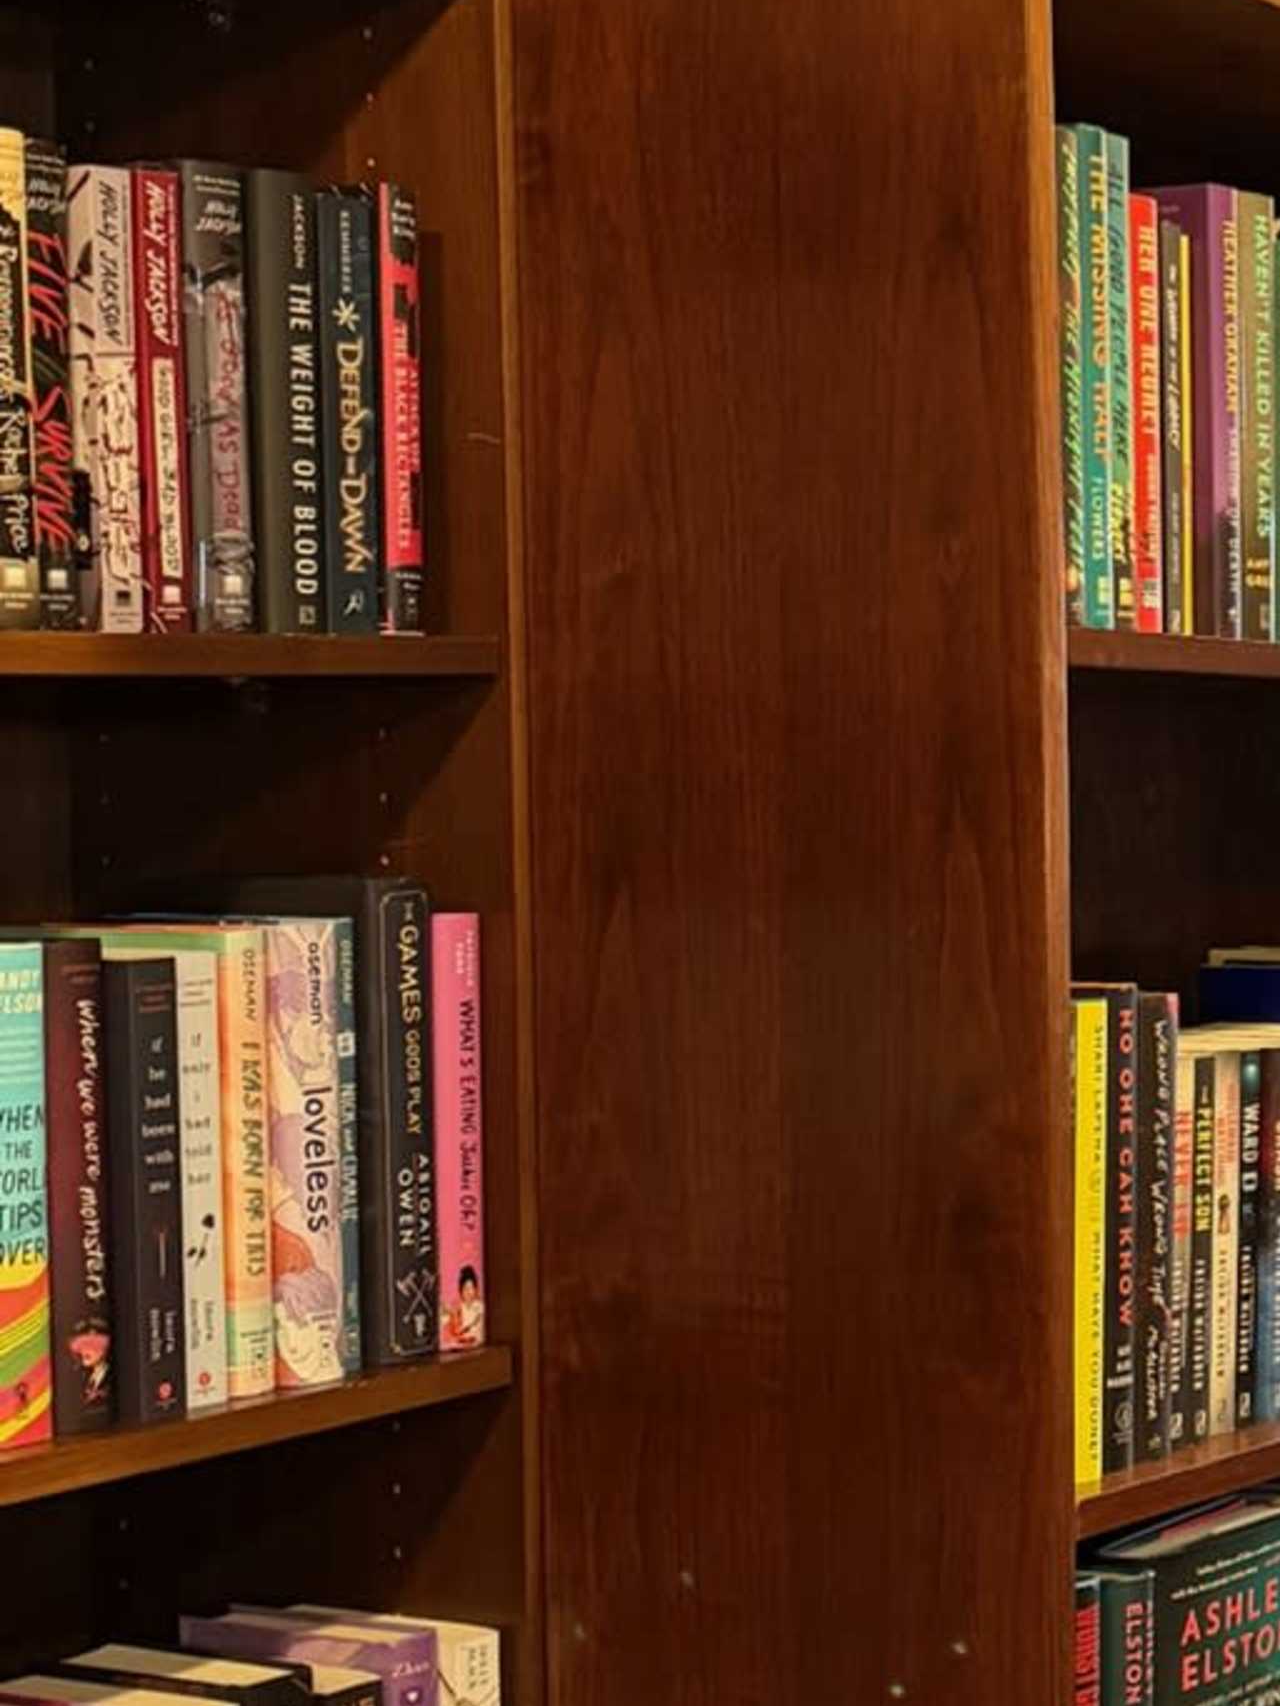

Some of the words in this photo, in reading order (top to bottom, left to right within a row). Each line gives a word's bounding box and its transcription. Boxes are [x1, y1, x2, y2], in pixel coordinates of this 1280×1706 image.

[144, 180, 164, 246] HOLLY
[1088, 154, 1107, 212] THE
[27, 230, 66, 340] FIVE
[1138, 225, 1157, 275] HER
[99, 250, 126, 346] JACKSON
[146, 249, 172, 347] JACKSON
[289, 283, 312, 332] THE
[1090, 223, 1110, 368] MISSING
[290, 343, 315, 448] WEIGHT
[337, 338, 366, 454] DEFEND
[1140, 344, 1160, 436] REGRET
[1255, 331, 1271, 416] KILLED
[31, 384, 74, 553] SURVIVE
[292, 459, 316, 494] OF
[1256, 423, 1271, 454] IN
[341, 473, 371, 574] DAWN
[1257, 460, 1272, 538] YEARS
[293, 505, 318, 596] BLOOD
[308, 941, 323, 1027] oseman
[398, 924, 424, 1024] GAMES
[1119, 1009, 1134, 1055] NO
[1153, 1018, 1170, 1101] WRONG
[460, 1075, 477, 1135] EATING
[1119, 1066, 1134, 1136] ONE
[1153, 1107, 1171, 1174] PLACE
[1241, 1102, 1260, 1165] WARD
[4, 1139, 33, 1162] THE
[301, 1084, 337, 1234] loveless
[1119, 1147, 1134, 1215] CAN
[1242, 1170, 1260, 1192] D
[78, 1185, 106, 1300] monsters
[399, 1169, 416, 1246] OWEN
[1151, 1180, 1169, 1256] WRONG
[1194, 1193, 1211, 1234] SON
[1119, 1226, 1135, 1327] KNOW
[1124, 1601, 1144, 1706] ELSTON
